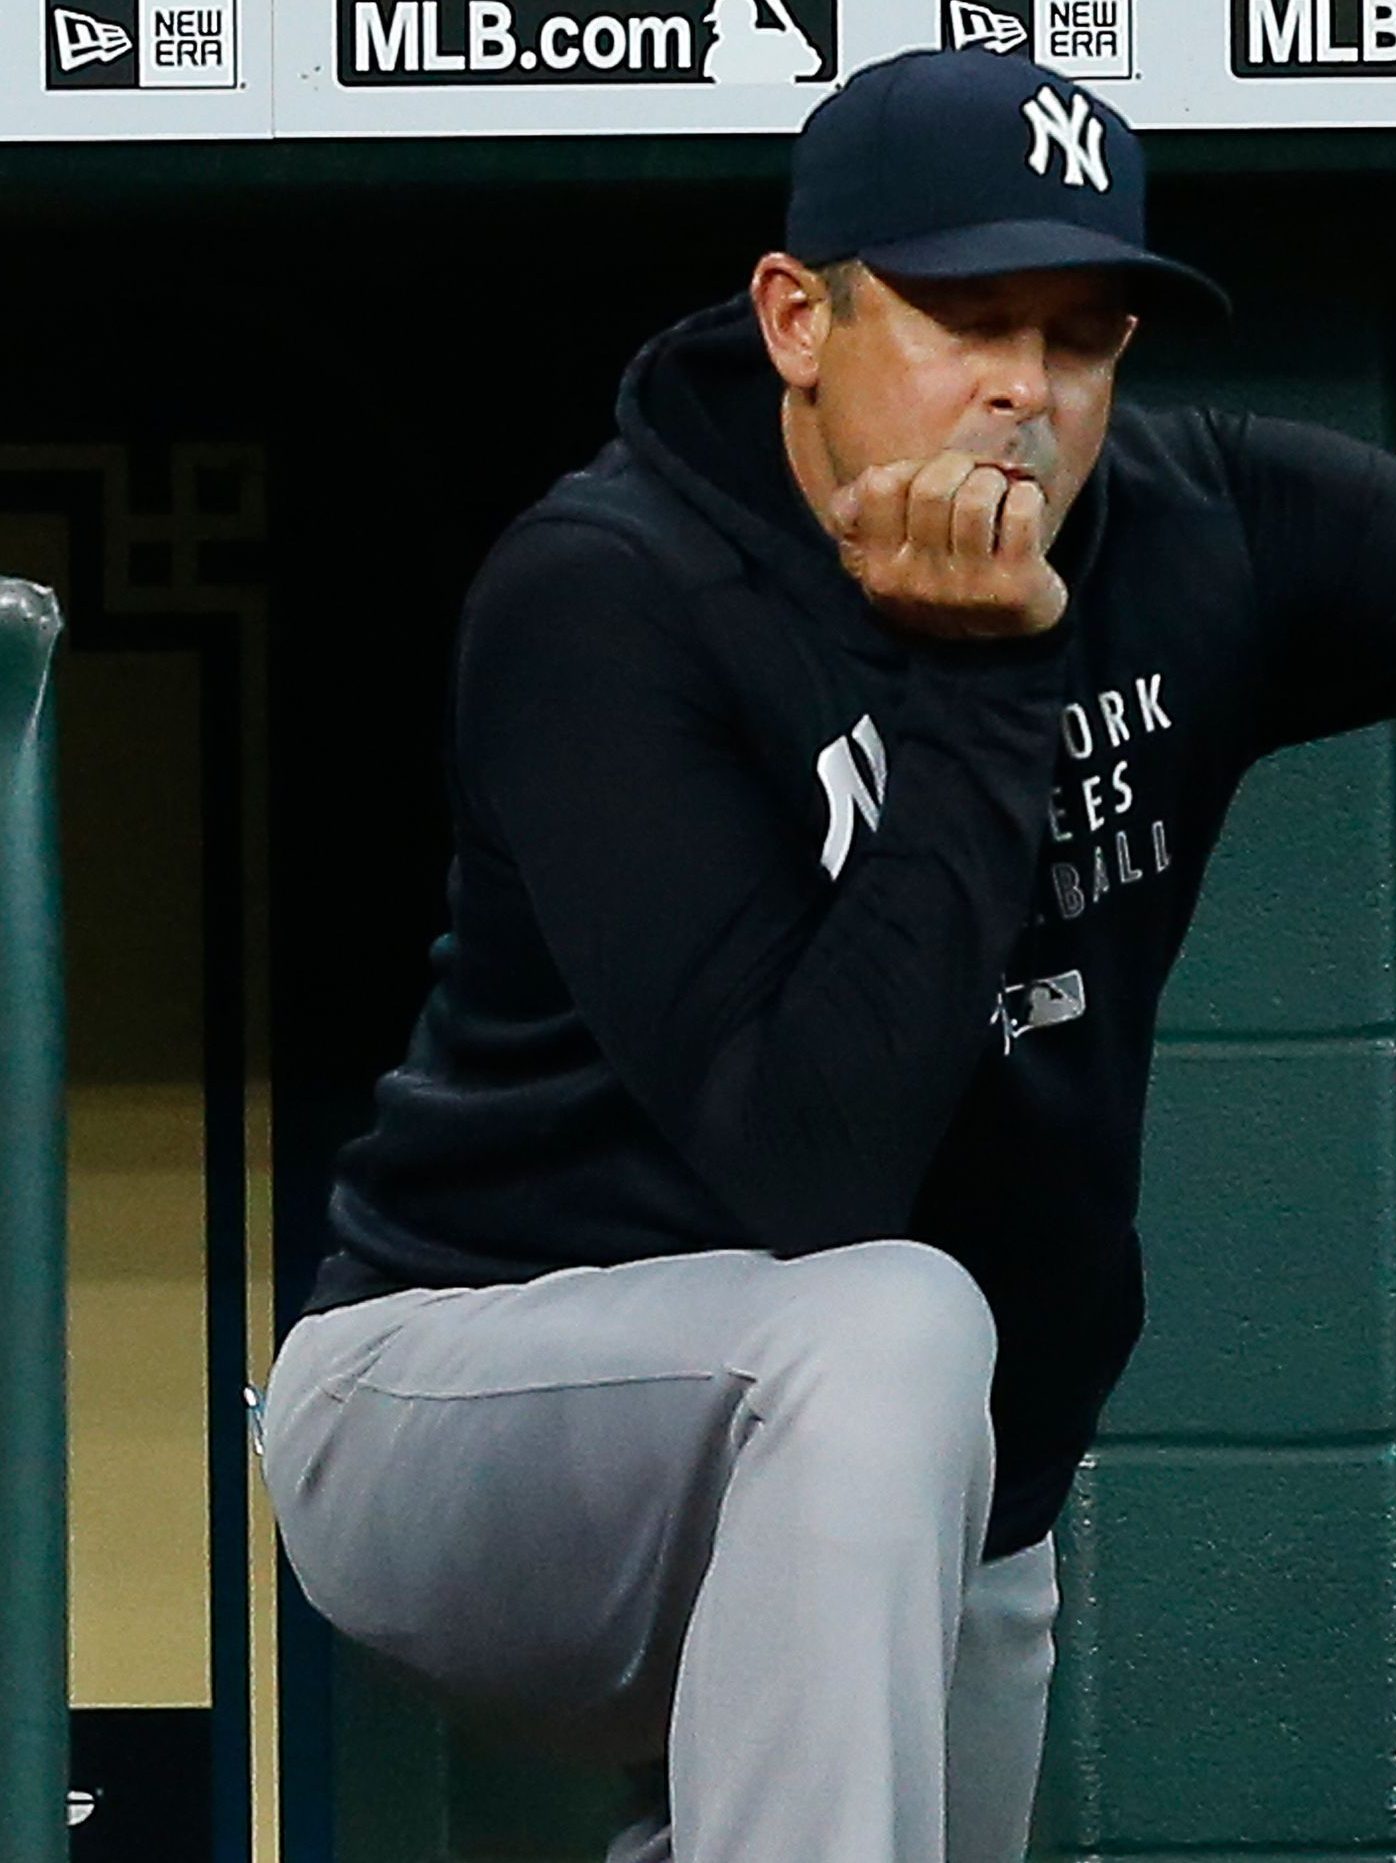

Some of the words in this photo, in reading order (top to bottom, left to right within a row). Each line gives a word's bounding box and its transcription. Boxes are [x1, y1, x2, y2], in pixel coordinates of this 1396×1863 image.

[154, 10, 222, 37] NEW
[355, 1, 692, 72] MLB.com
[1050, 2, 1117, 28] NEW
[154, 39, 222, 66] ERA
[1050, 30, 1117, 57] ERA
[1023, 86, 1110, 192] NY
[1060, 673, 1173, 760] ORK
[1048, 759, 1134, 843] EES
